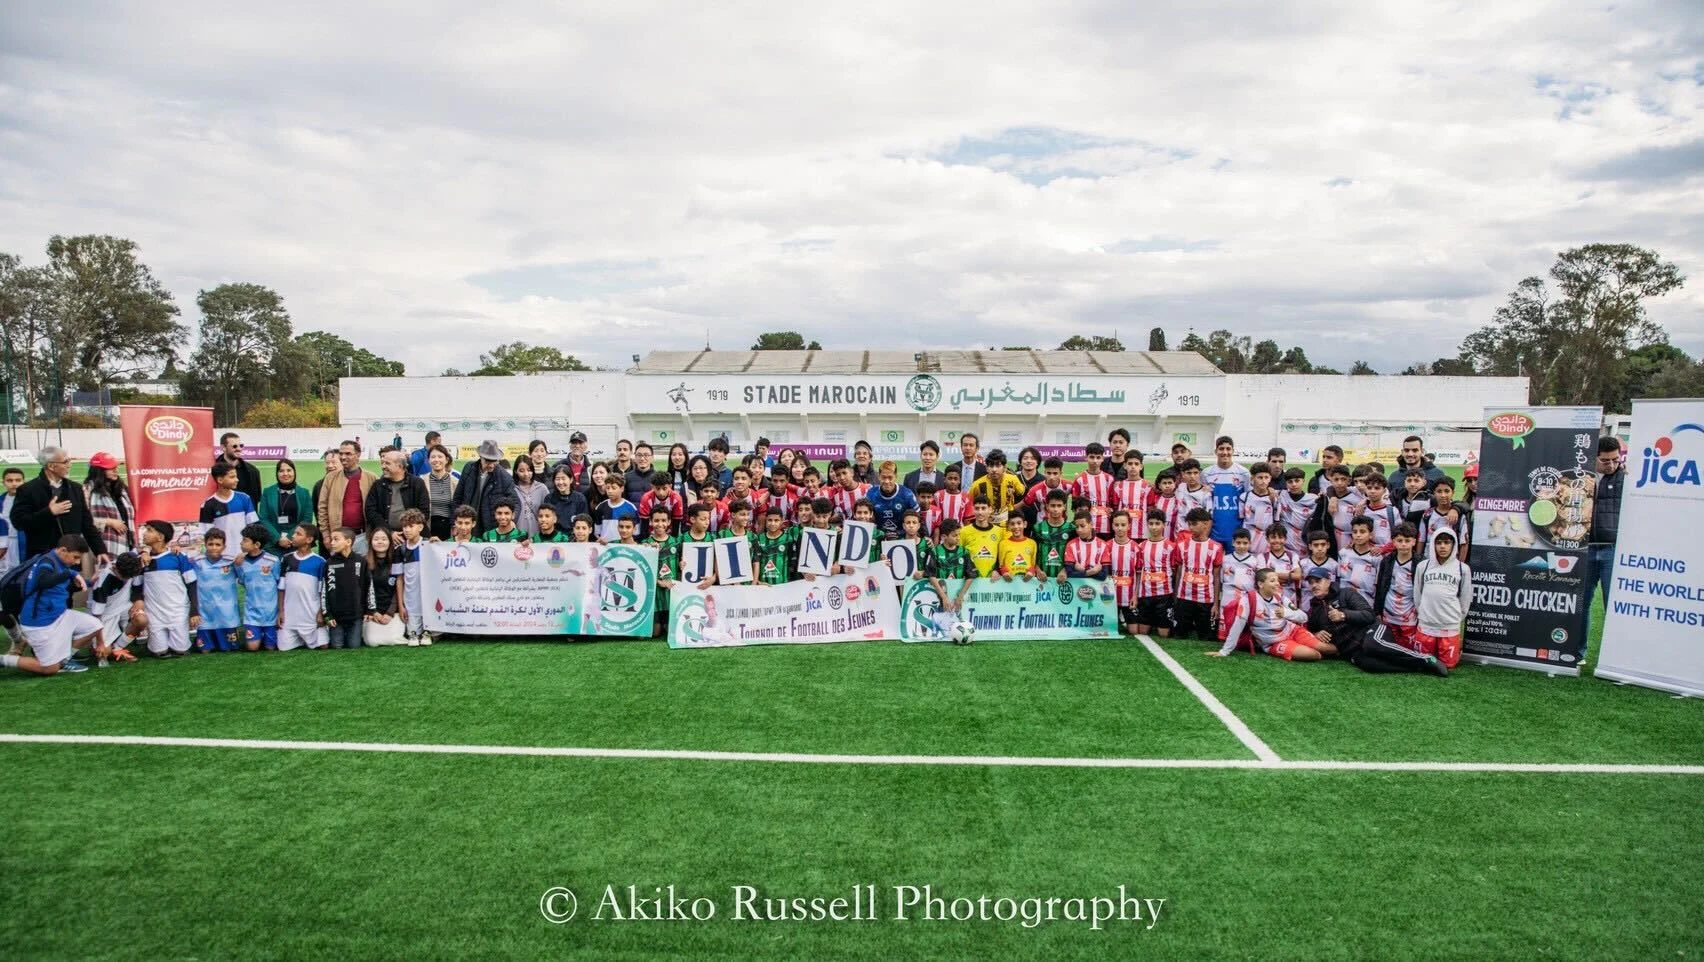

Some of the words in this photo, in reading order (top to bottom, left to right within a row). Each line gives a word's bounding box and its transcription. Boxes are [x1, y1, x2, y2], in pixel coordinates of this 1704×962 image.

[707, 390, 728, 400] 1919
[744, 385, 800, 404] STADE
[809, 386, 896, 404] MAROCAIN
[950, 381, 1048, 409] المغربي
[1052, 382, 1125, 403] سطاد
[1178, 395, 1200, 406] 1919
[150, 420, 184, 435] داندي
[1492, 415, 1527, 428] داندي
[158, 430, 188, 440] Dindy
[1499, 424, 1530, 434] Dindy
[258, 448, 284, 456] inwi
[814, 448, 843, 456] inwi
[140, 467, 186, 475] CONVIVIALITÉ
[1478, 498, 1526, 512] GINGEMBRE
[684, 546, 712, 584] J
[722, 541, 748, 579] I
[802, 532, 836, 572] N
[844, 524, 870, 562] D
[887, 544, 916, 580] O
[1620, 554, 1686, 574] LEADING
[1424, 572, 1457, 585] ATLANTA
[1472, 572, 1506, 584] JAPANESE
[1522, 570, 1546, 580] Recette
[1617, 577, 1645, 592] THE
[1648, 582, 1704, 602] WORLD
[1471, 584, 1512, 606] FRIED
[1514, 588, 1577, 614] CHICKEN
[968, 608, 1002, 630] TOURNOI
[1004, 615, 1015, 630] DE
[1018, 606, 1055, 629] FOOTBALL
[1059, 614, 1072, 628] DES
[1074, 606, 1104, 628] JEUNES
[1504, 614, 1520, 622] POULET
[1614, 600, 1650, 618] WITH
[1655, 607, 1704, 626] TRUST
[778, 626, 786, 638] DE
[791, 616, 829, 638] FOOTBALL
[832, 617, 845, 633] DES
[847, 608, 876, 631] JEUNES
[1448, 646, 1455, 658] 7
